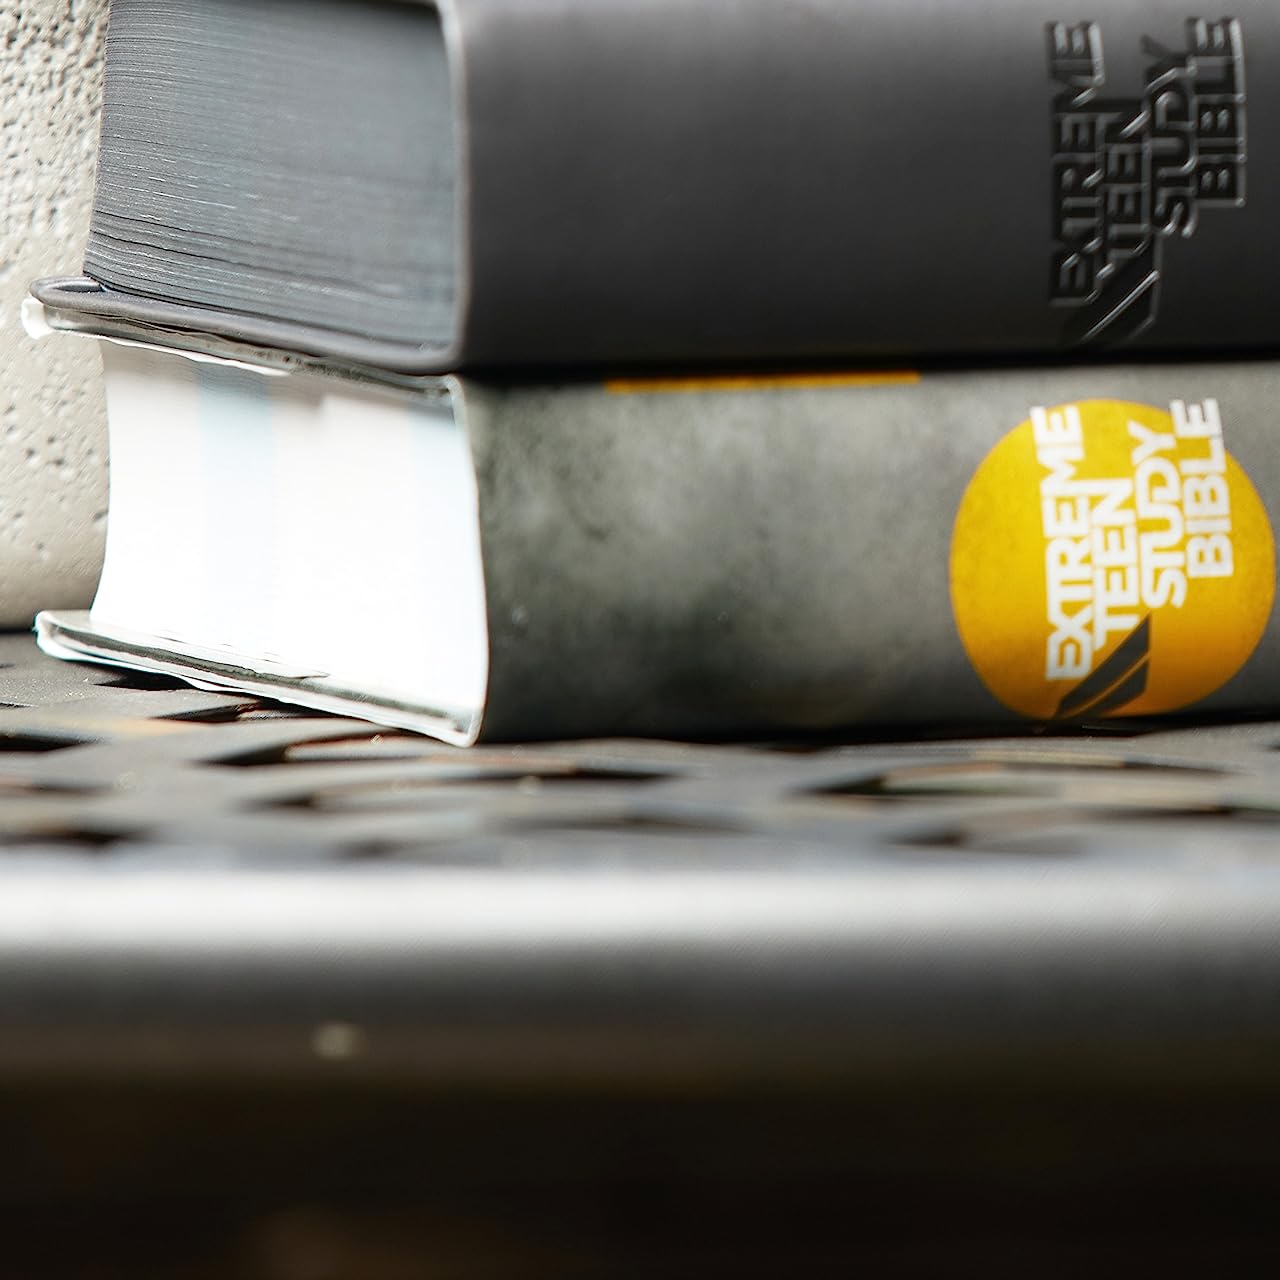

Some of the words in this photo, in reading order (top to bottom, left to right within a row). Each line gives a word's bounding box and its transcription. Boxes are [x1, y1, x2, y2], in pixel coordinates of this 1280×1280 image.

[1045, 19, 1104, 306] EXTREME
[1096, 98, 1152, 278] TEEN
[1141, 33, 1198, 238] STUDY
[1187, 17, 1245, 207] BIBLE
[1030, 405, 1093, 680] EXTREME
[1091, 478, 1140, 651] TEEN
[1127, 421, 1188, 608] STUDY
[1170, 398, 1234, 578] BIBLE
